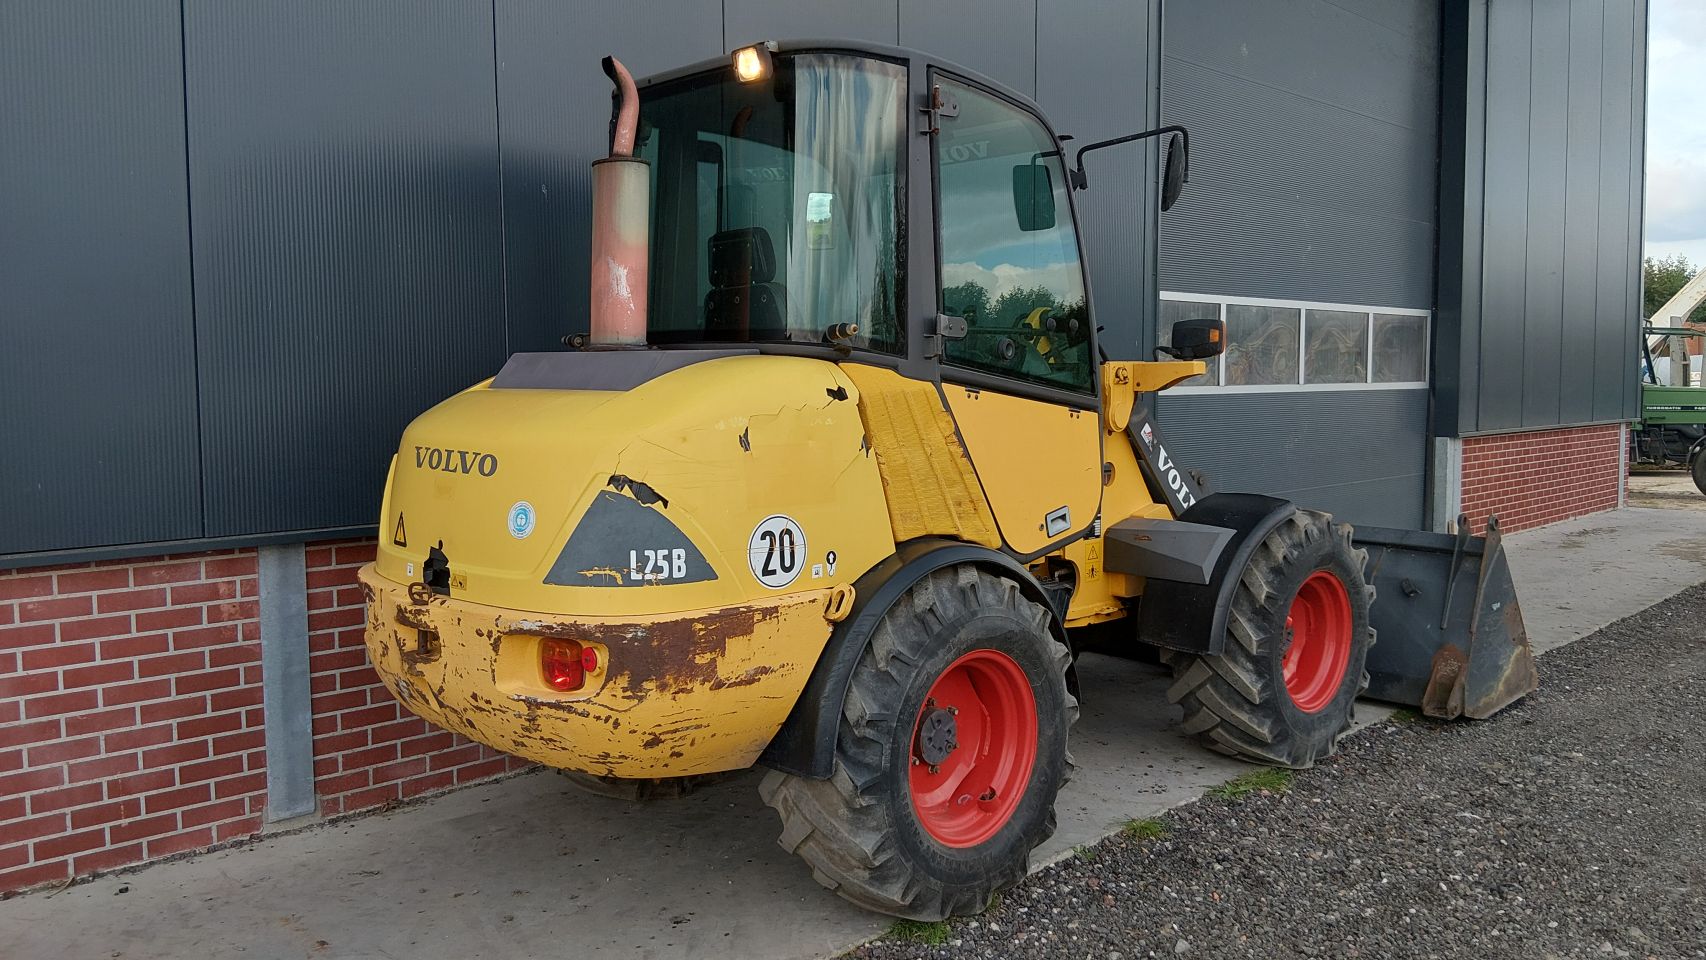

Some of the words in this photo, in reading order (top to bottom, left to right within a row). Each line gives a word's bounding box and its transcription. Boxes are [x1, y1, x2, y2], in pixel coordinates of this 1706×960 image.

[415, 446, 498, 477] VOLVO
[630, 548, 687, 580] L25B
[760, 528, 796, 577] 20
